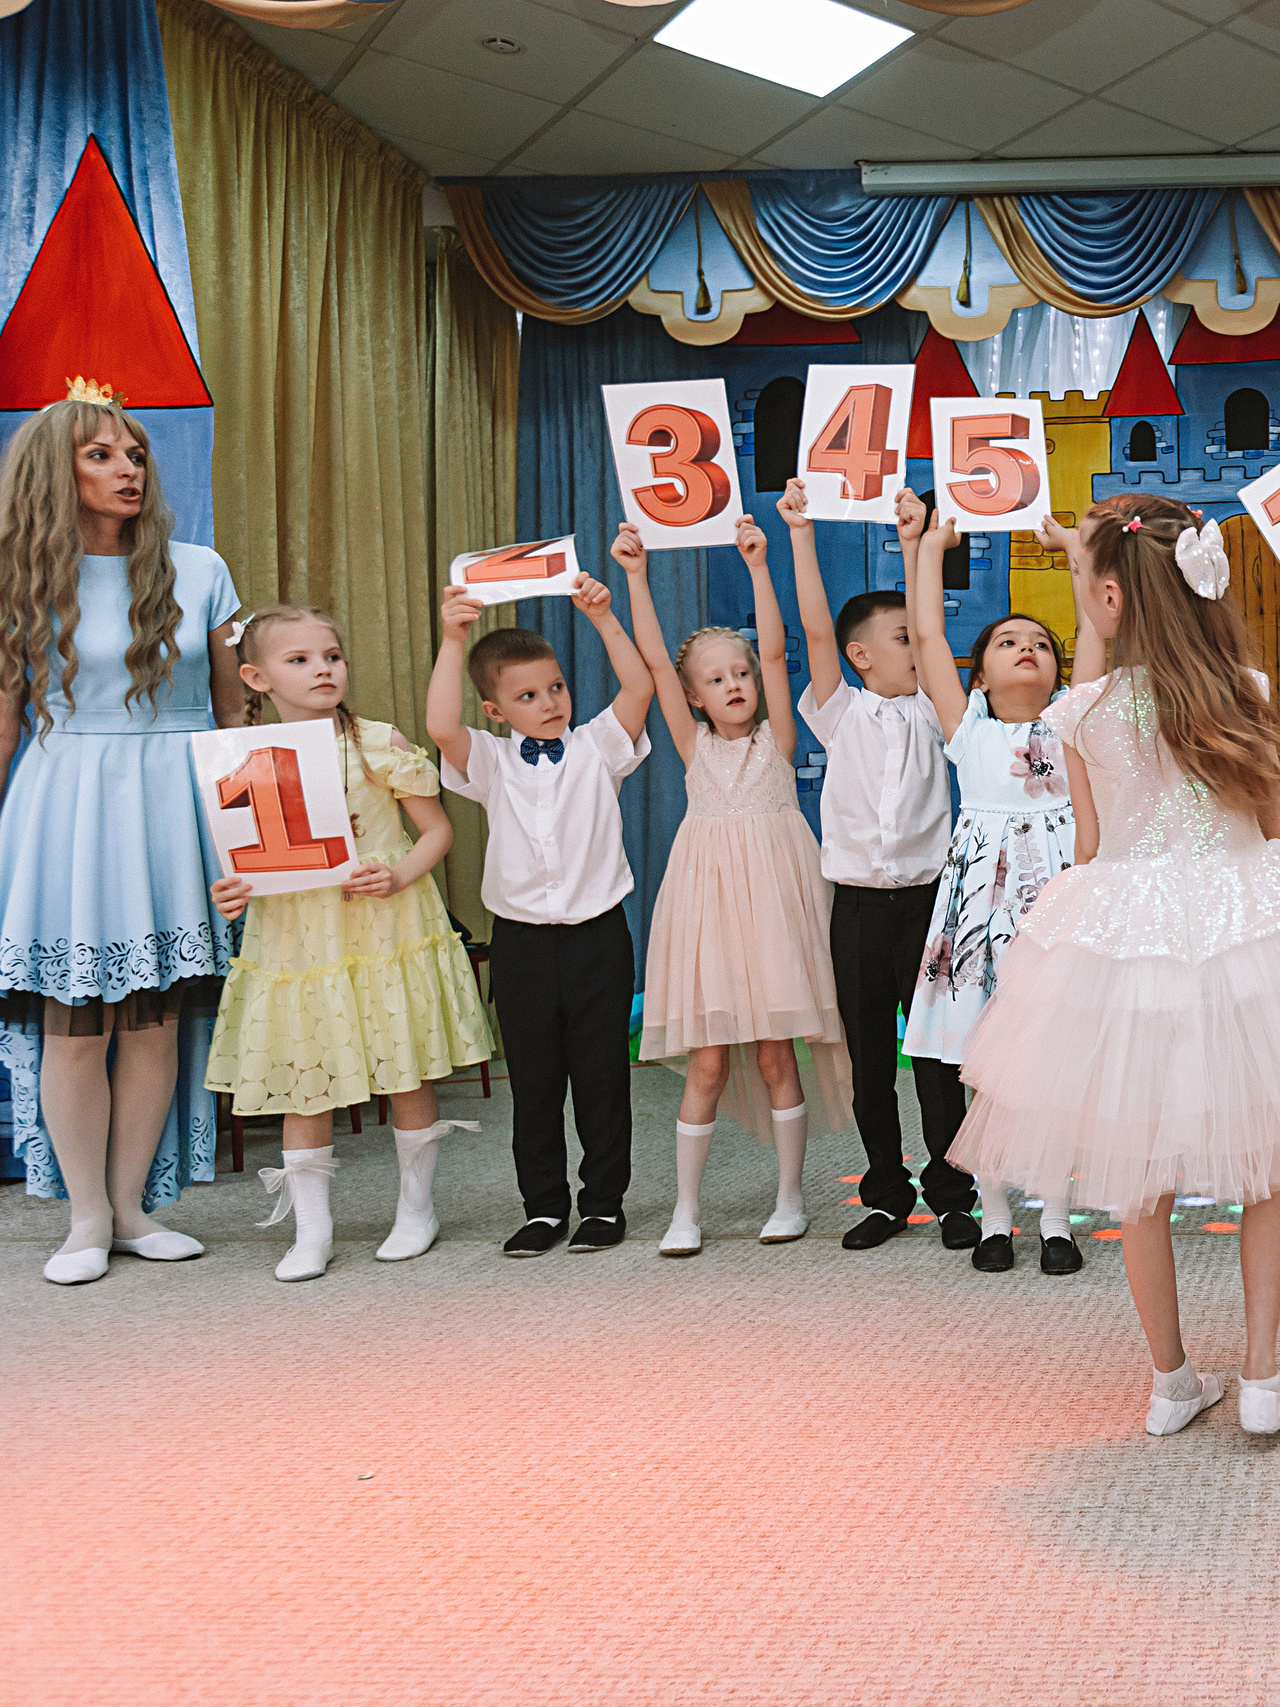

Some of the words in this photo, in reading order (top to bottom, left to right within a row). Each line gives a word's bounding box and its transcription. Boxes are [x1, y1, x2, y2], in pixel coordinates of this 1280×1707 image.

[626, 405, 731, 528] 3
[807, 384, 898, 500] 4
[946, 414, 1039, 516] 5
[217, 747, 349, 873] 1
